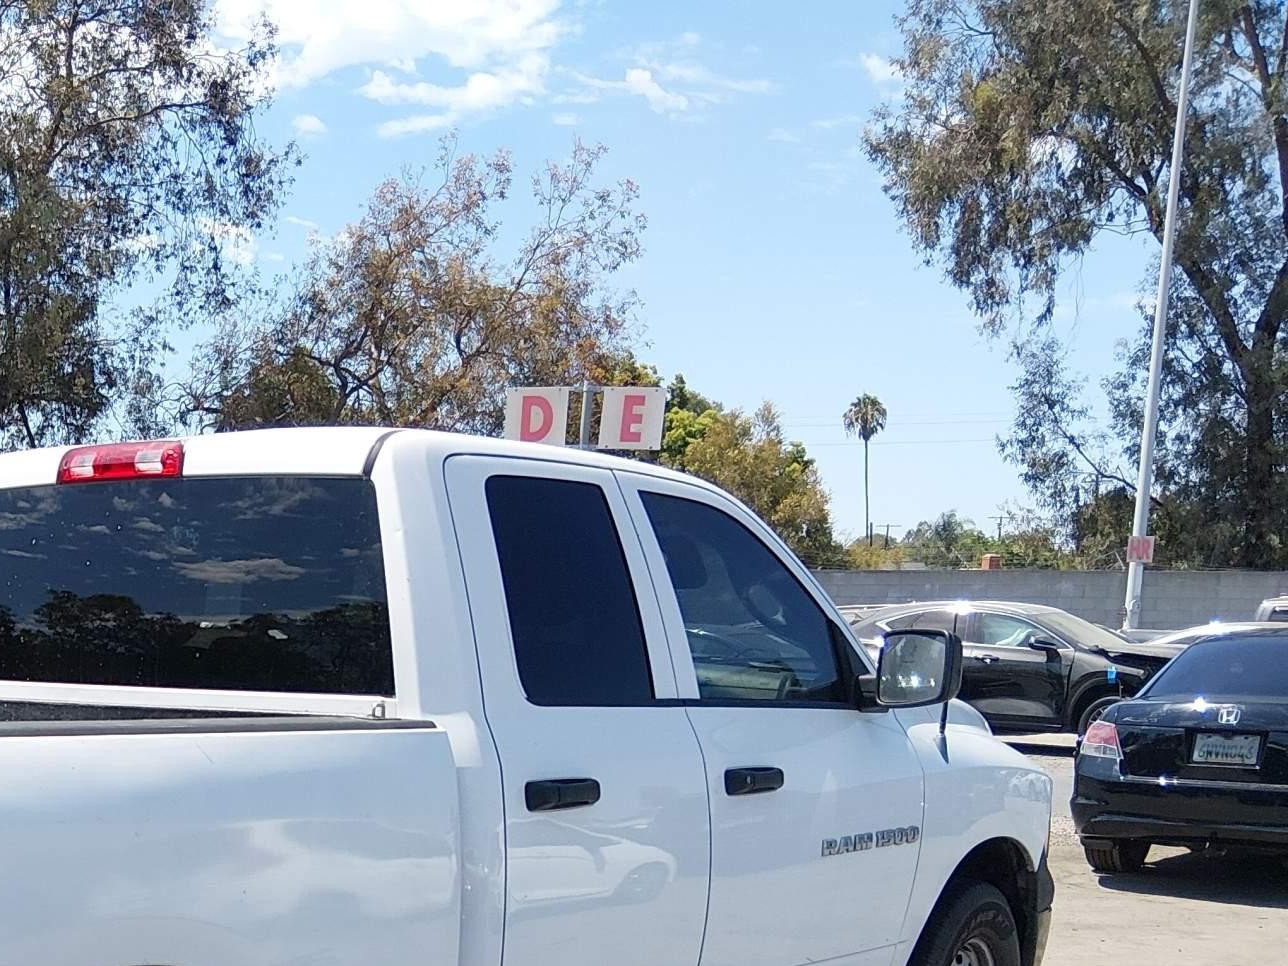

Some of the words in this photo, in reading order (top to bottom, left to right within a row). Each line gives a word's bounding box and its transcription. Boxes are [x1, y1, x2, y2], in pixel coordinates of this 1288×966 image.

[520, 395, 554, 443] D
[619, 394, 646, 443] E
[821, 832, 873, 856] RAM
[875, 825, 920, 848] 1500
